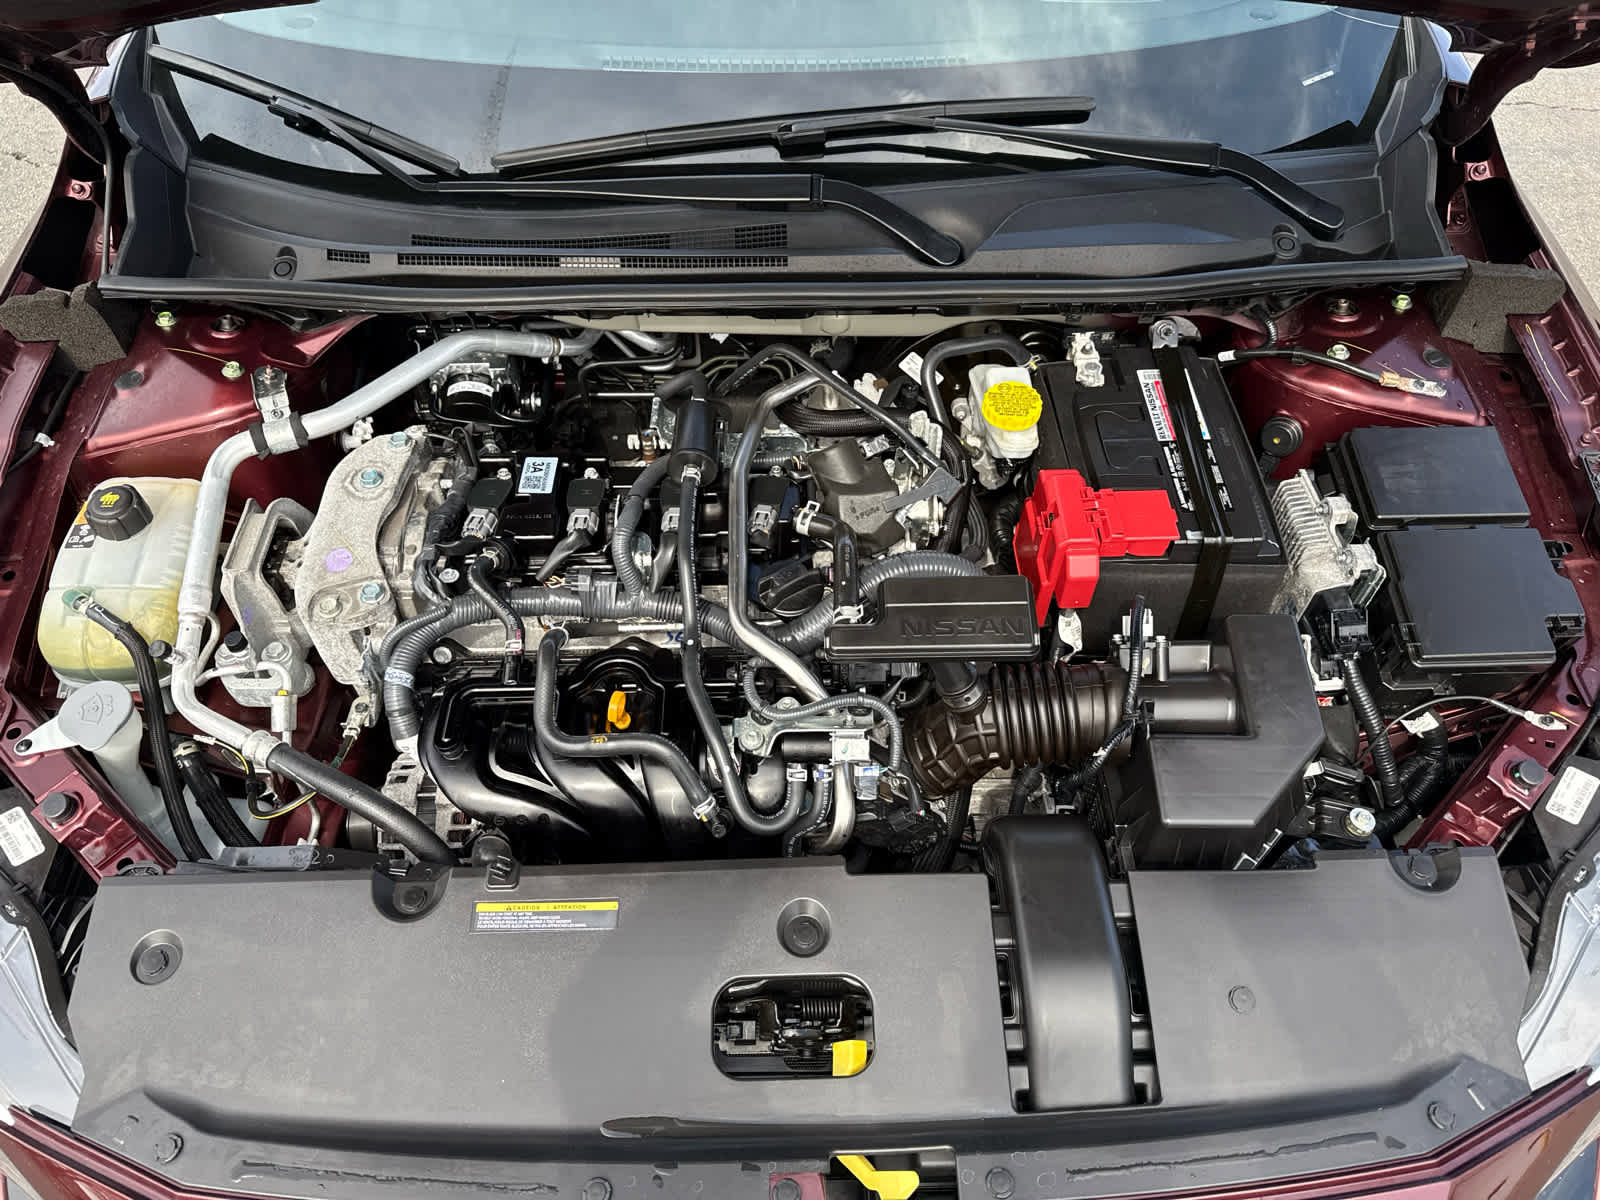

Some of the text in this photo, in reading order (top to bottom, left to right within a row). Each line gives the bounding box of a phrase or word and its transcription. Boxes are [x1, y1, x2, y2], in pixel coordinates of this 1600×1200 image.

[1143, 382, 1158, 411] NISSAN
[531, 461, 545, 474] 3A
[900, 616, 1025, 638] NISSAN
